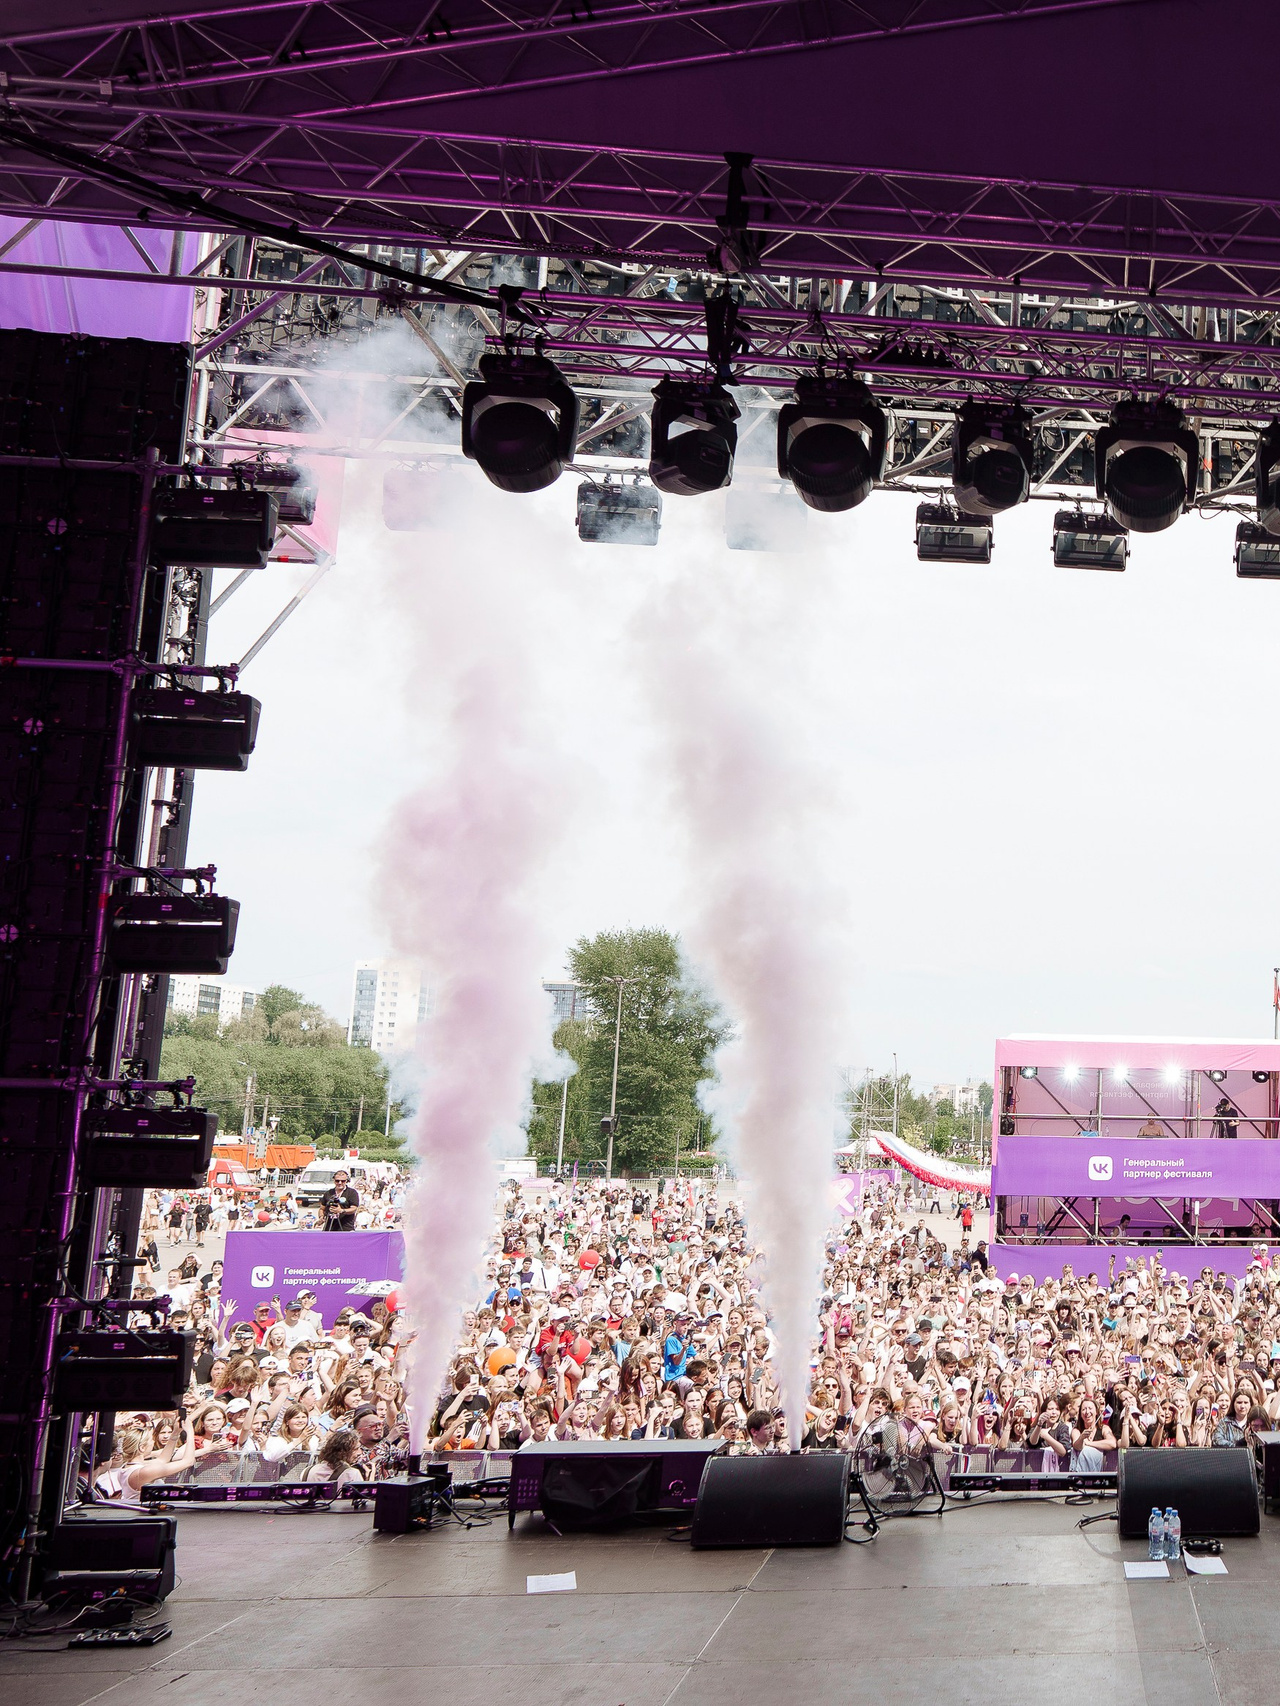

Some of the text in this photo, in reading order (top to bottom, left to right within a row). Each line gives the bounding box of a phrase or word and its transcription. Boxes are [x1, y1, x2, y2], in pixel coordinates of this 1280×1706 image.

[1123, 1158, 1185, 1168] Генеральный
[1123, 1170, 1213, 1179] партнер фестиваля
[283, 1267, 341, 1275] Генеральный
[283, 1276, 367, 1286] партнер фестиваля
